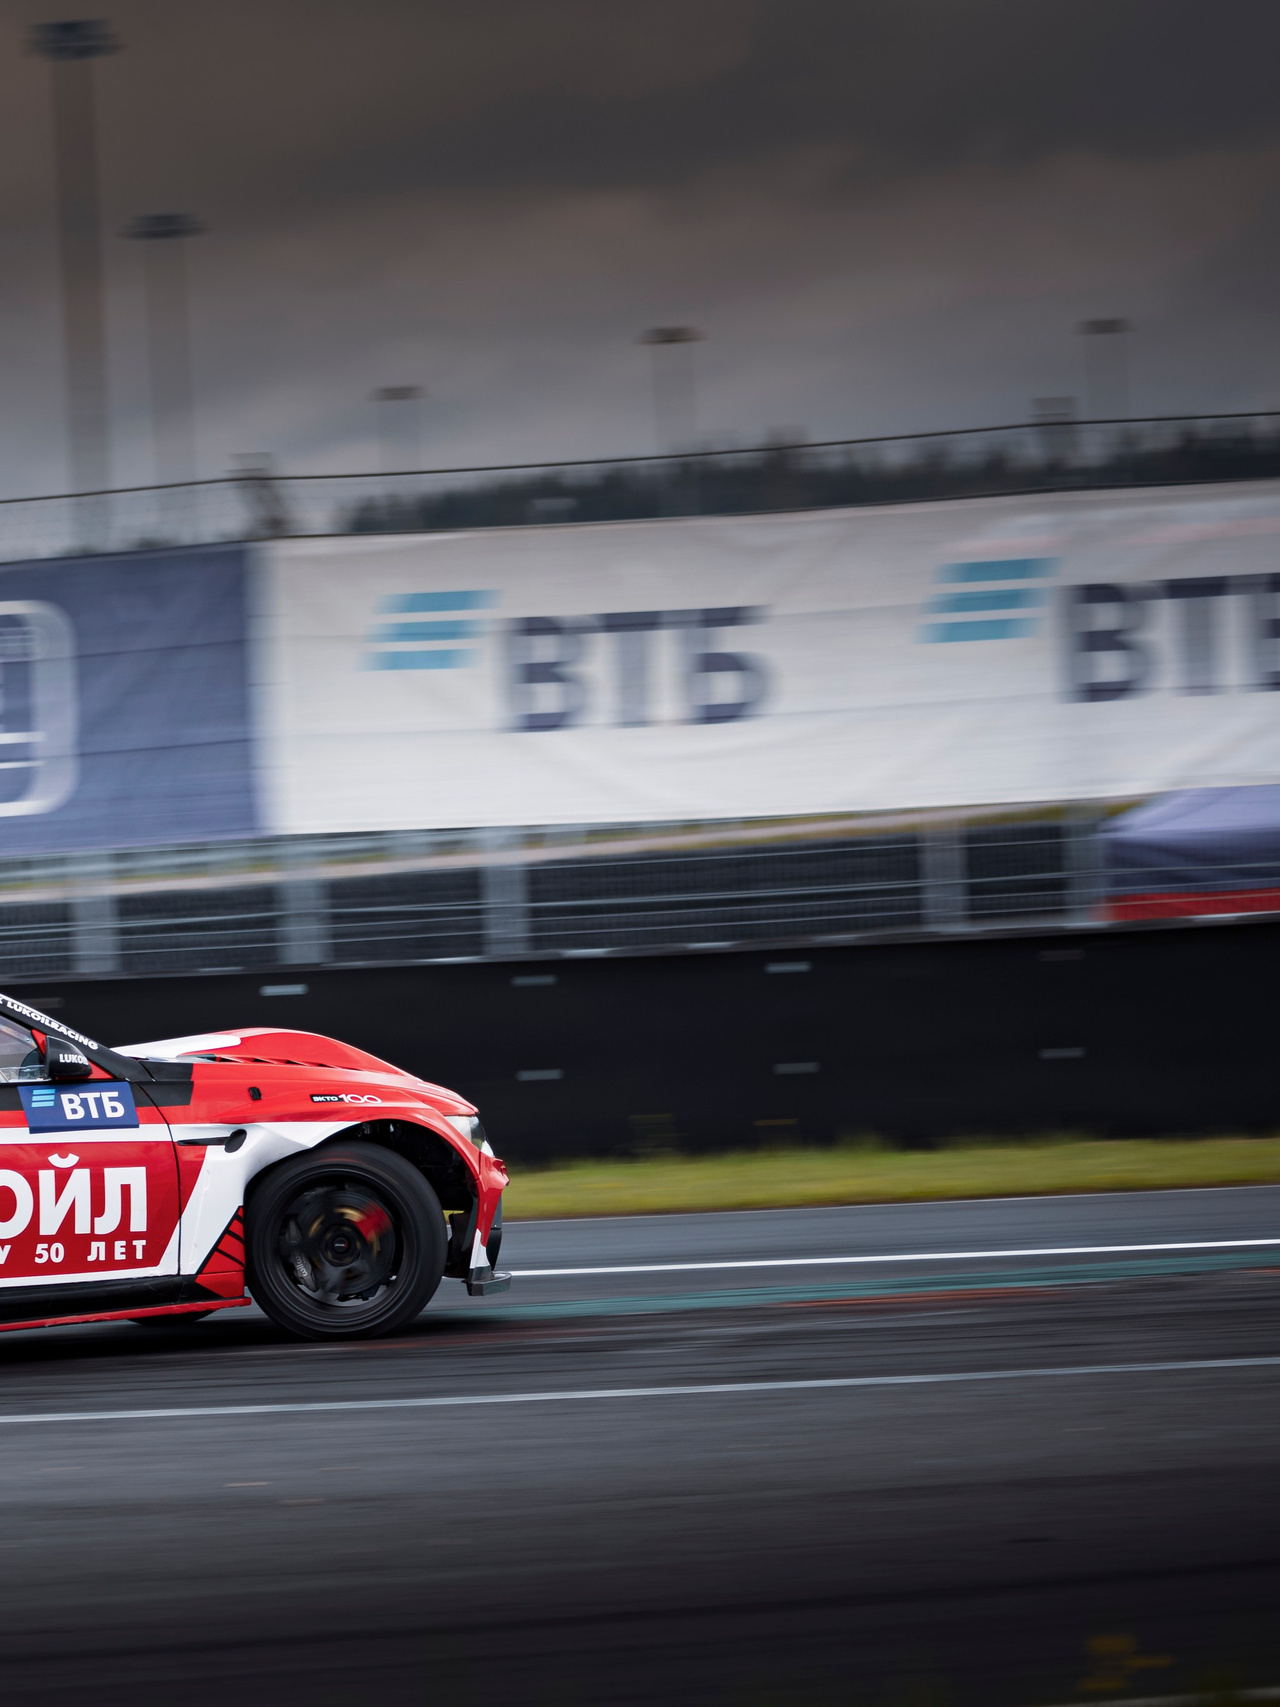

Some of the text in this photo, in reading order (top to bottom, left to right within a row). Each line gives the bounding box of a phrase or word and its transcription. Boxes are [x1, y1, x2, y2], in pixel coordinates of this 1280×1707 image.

[500, 605, 780, 733] ВТБ
[7, 1001, 98, 1050] LUKOILRACING
[61, 1090, 126, 1120] ВТБ
[338, 1093, 382, 1104] 100
[34, 1242, 65, 1264] 50
[87, 1239, 147, 1261] ЛЕТ
